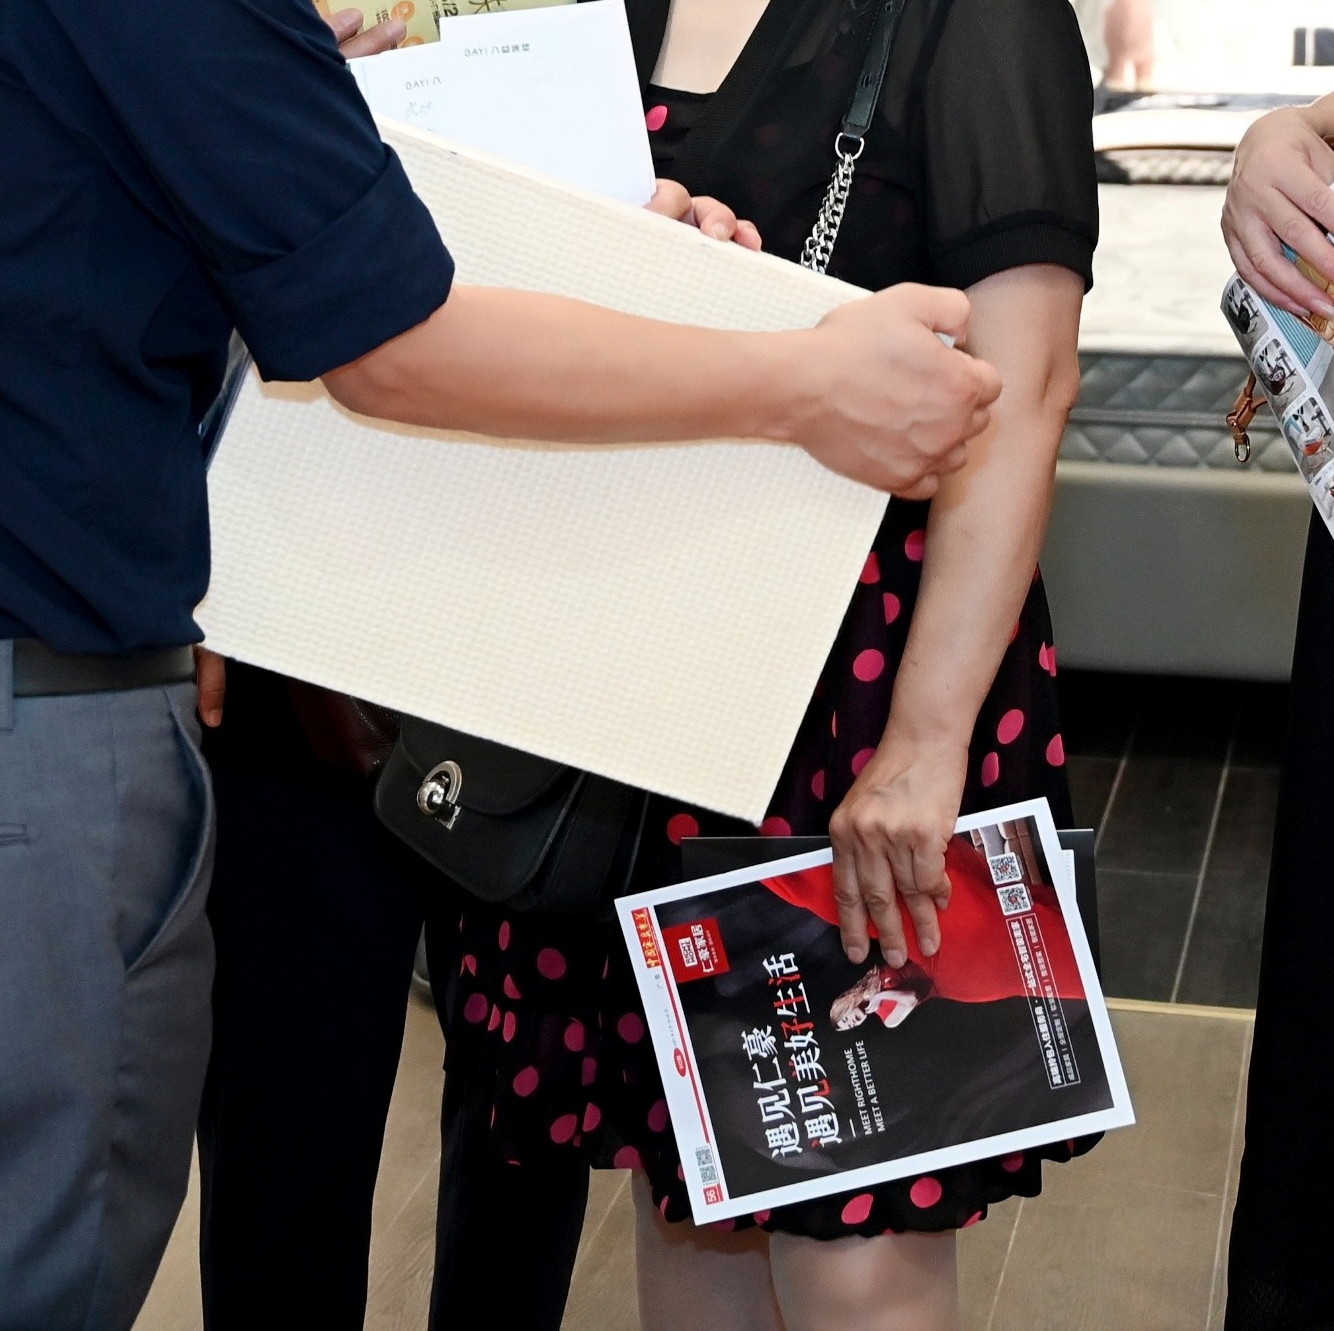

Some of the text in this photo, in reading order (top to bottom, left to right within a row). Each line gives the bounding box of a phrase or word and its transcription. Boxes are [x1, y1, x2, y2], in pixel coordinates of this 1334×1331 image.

[762, 953, 842, 1148] 遇见美好生活
[855, 1040, 868, 1060] LIFE
[861, 1061, 876, 1097] BETTER
[741, 1025, 803, 1158] 遇见仁豪
[844, 1048, 872, 1135] MEET RIGHTHOME
[871, 1107, 885, 1132] MEET
